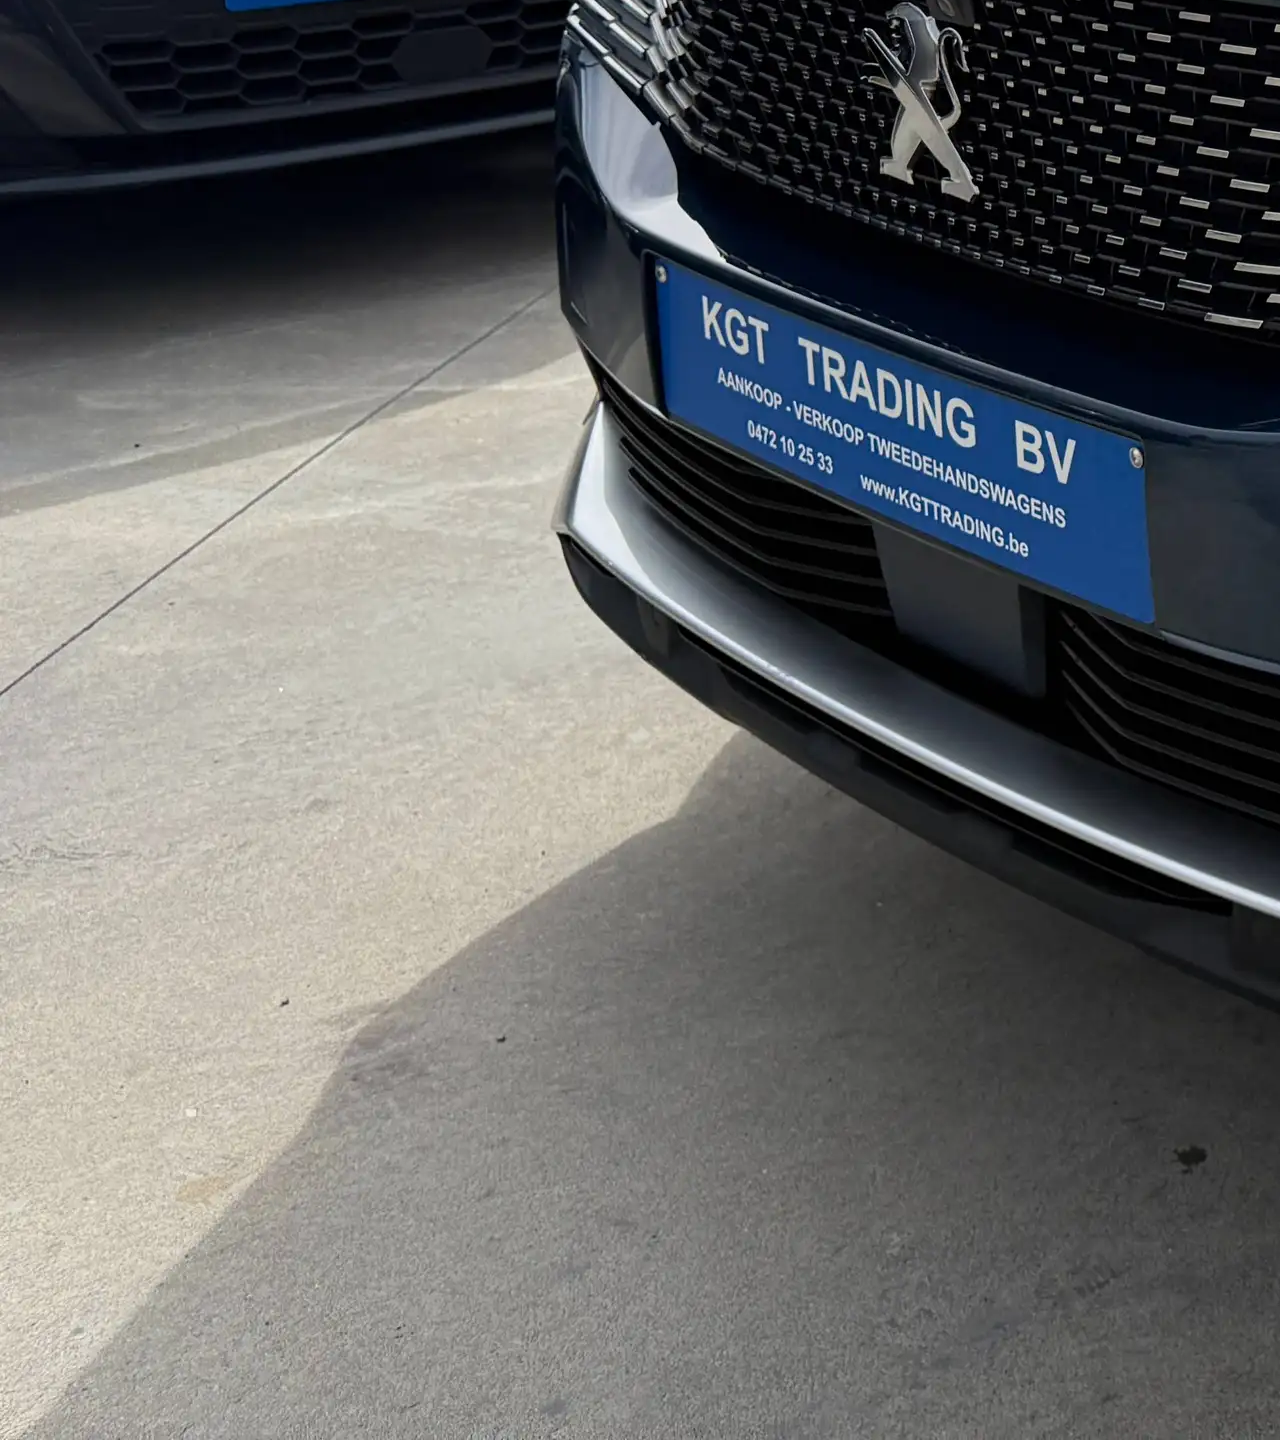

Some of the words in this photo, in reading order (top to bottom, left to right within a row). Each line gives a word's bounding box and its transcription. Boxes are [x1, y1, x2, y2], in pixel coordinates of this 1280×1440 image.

[701, 295, 769, 365] KGT
[798, 336, 977, 449] TRADING
[1014, 419, 1077, 485] BV
[717, 367, 783, 410] AANKOOP
[793, 400, 864, 446] VERKOOP
[867, 432, 1067, 528] TWEEDEHANDSWAGENS
[747, 419, 777, 450] 0472
[780, 435, 796, 457] 10
[798, 443, 815, 466] 25
[817, 452, 834, 475] 33
[860, 474, 1030, 558] www.KGTTRADING.be
